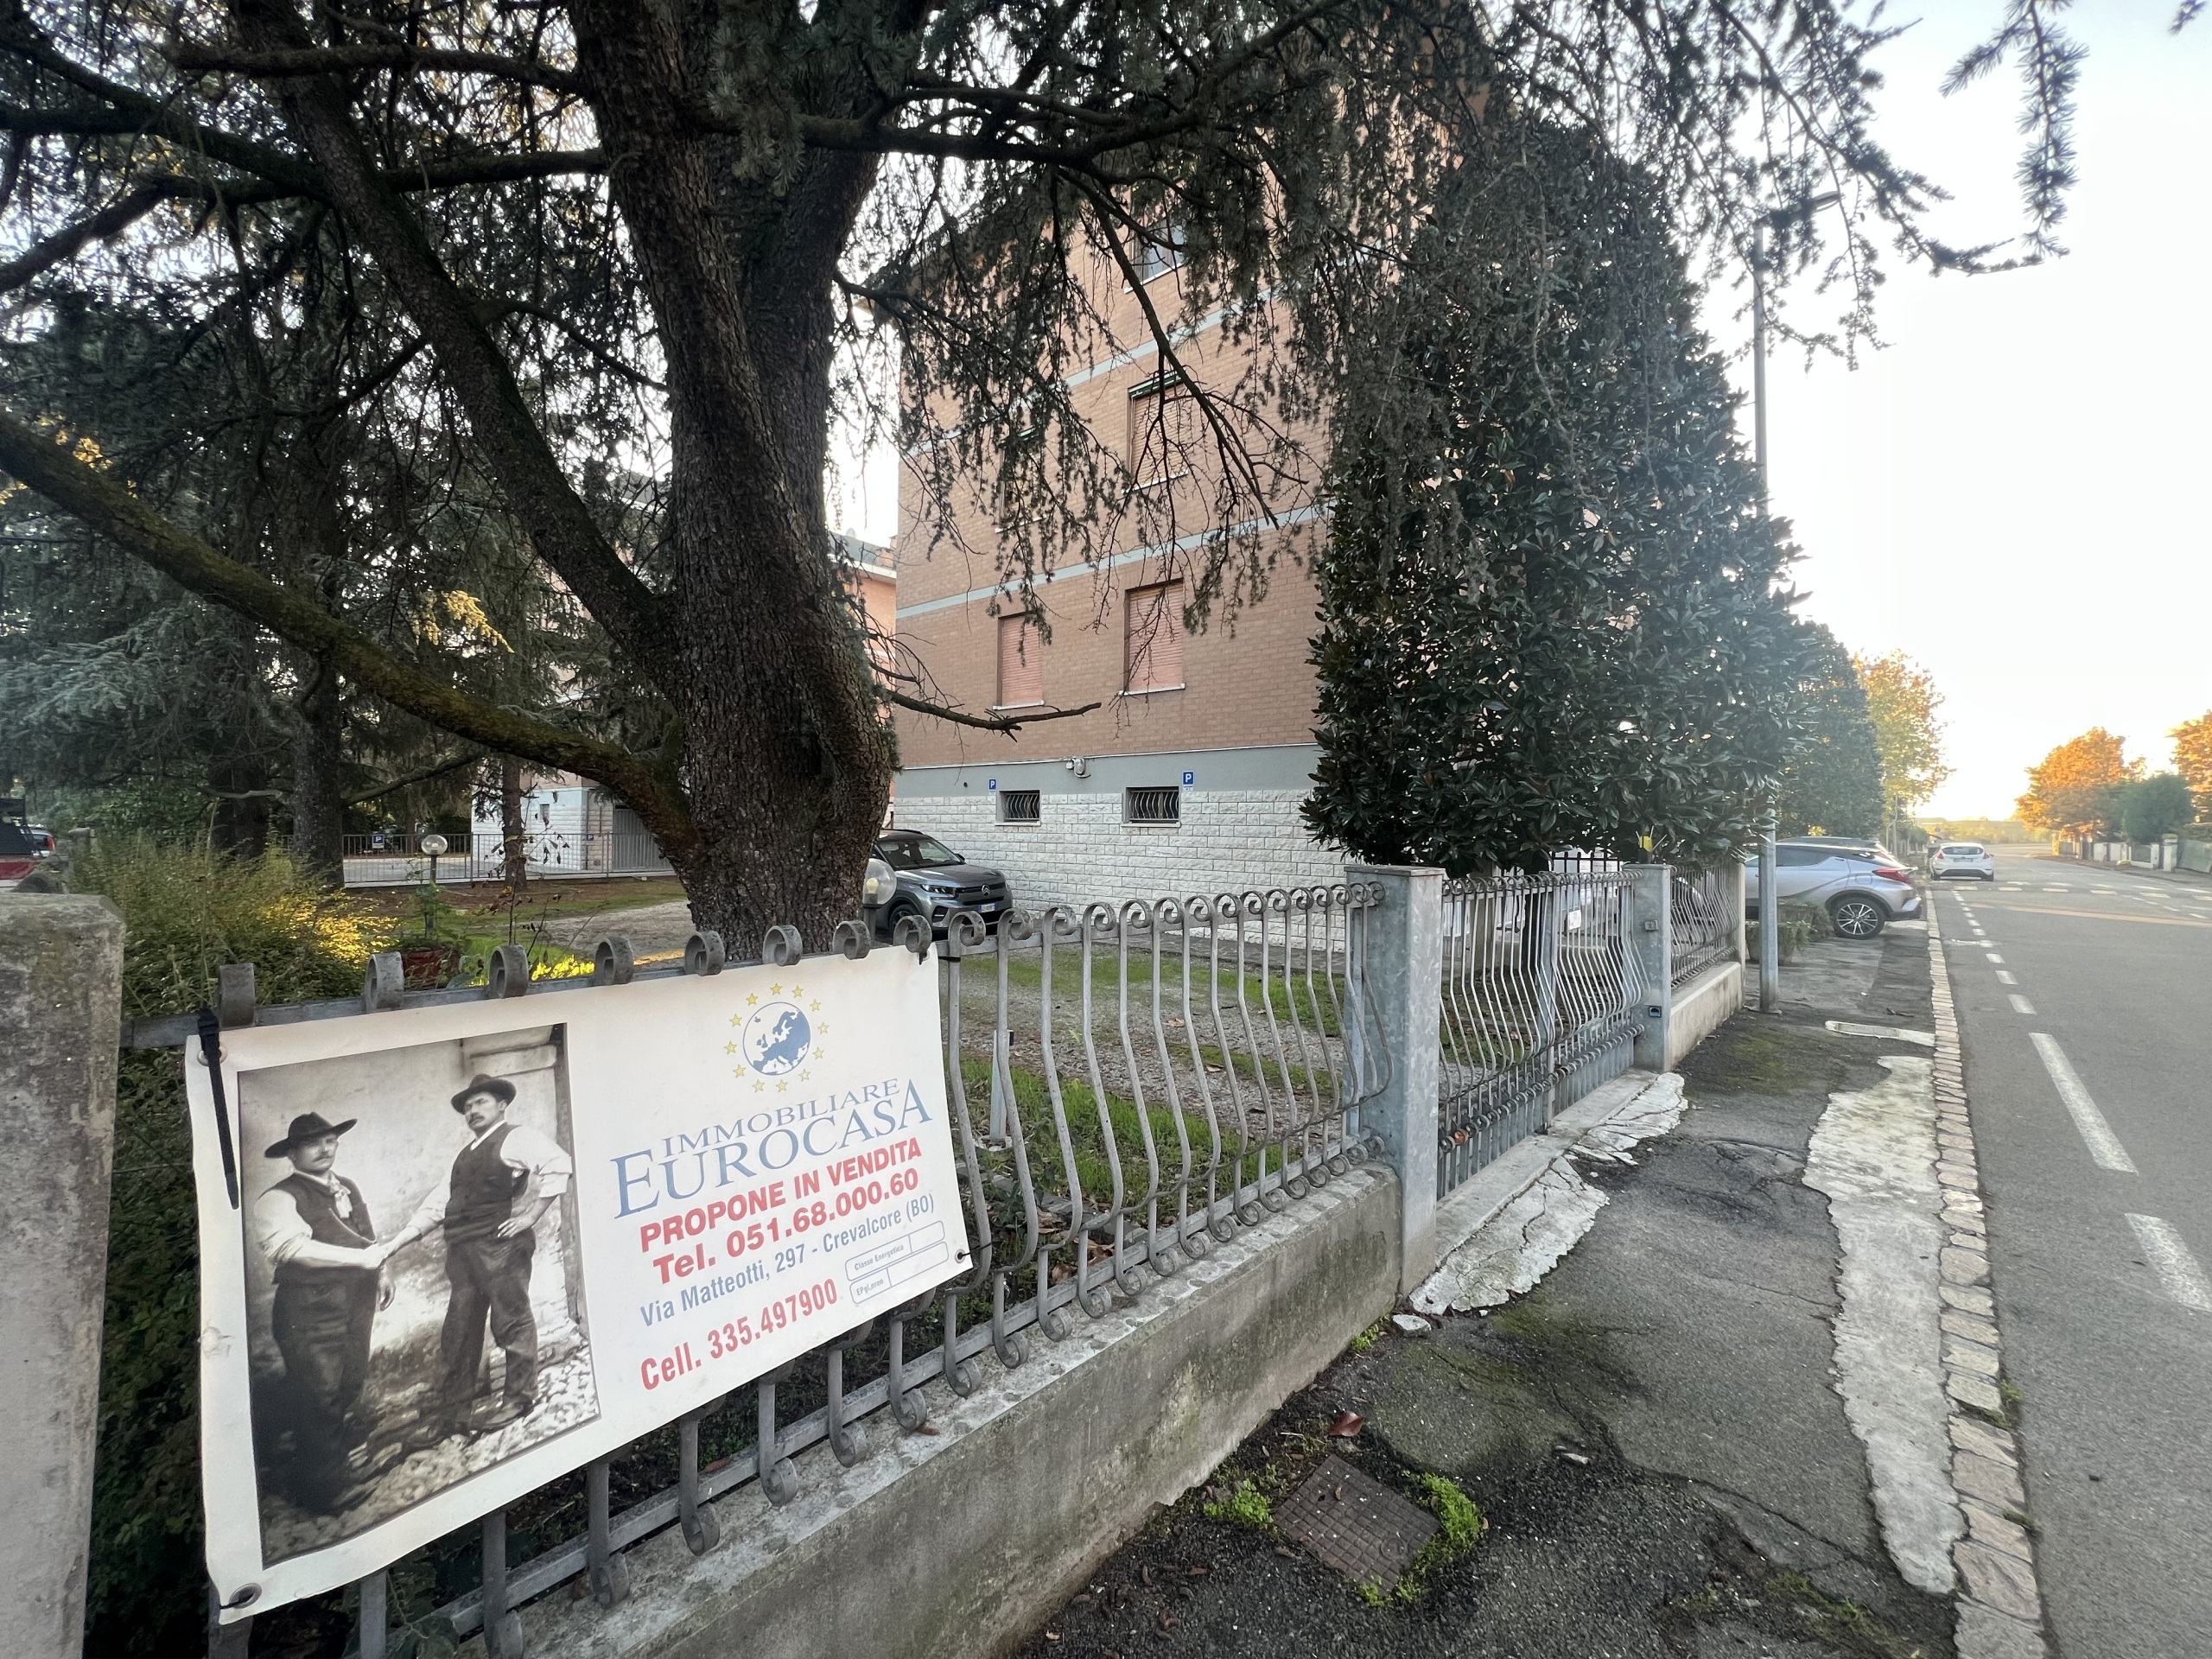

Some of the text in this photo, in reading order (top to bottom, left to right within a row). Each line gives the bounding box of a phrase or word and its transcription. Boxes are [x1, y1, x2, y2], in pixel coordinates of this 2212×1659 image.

[990, 780, 995, 789] P
[1185, 773, 1192, 783] P
[610, 1078, 933, 1220] EUROCASA
[662, 1077, 902, 1158] IMMOBILIARE
[640, 1137, 922, 1253] PROPONE IN VENDITA
[652, 1166, 919, 1286] Tel. 051.68.000.60
[640, 1299, 675, 1327] Via
[681, 1260, 771, 1312] Matteotti,
[775, 1243, 806, 1274] 297
[822, 1208, 902, 1254] Crevalcore
[906, 1192, 935, 1224] (BO)
[855, 1244, 904, 1270] Classe Energetica
[641, 1276, 838, 1391] Cell. 335.497900
